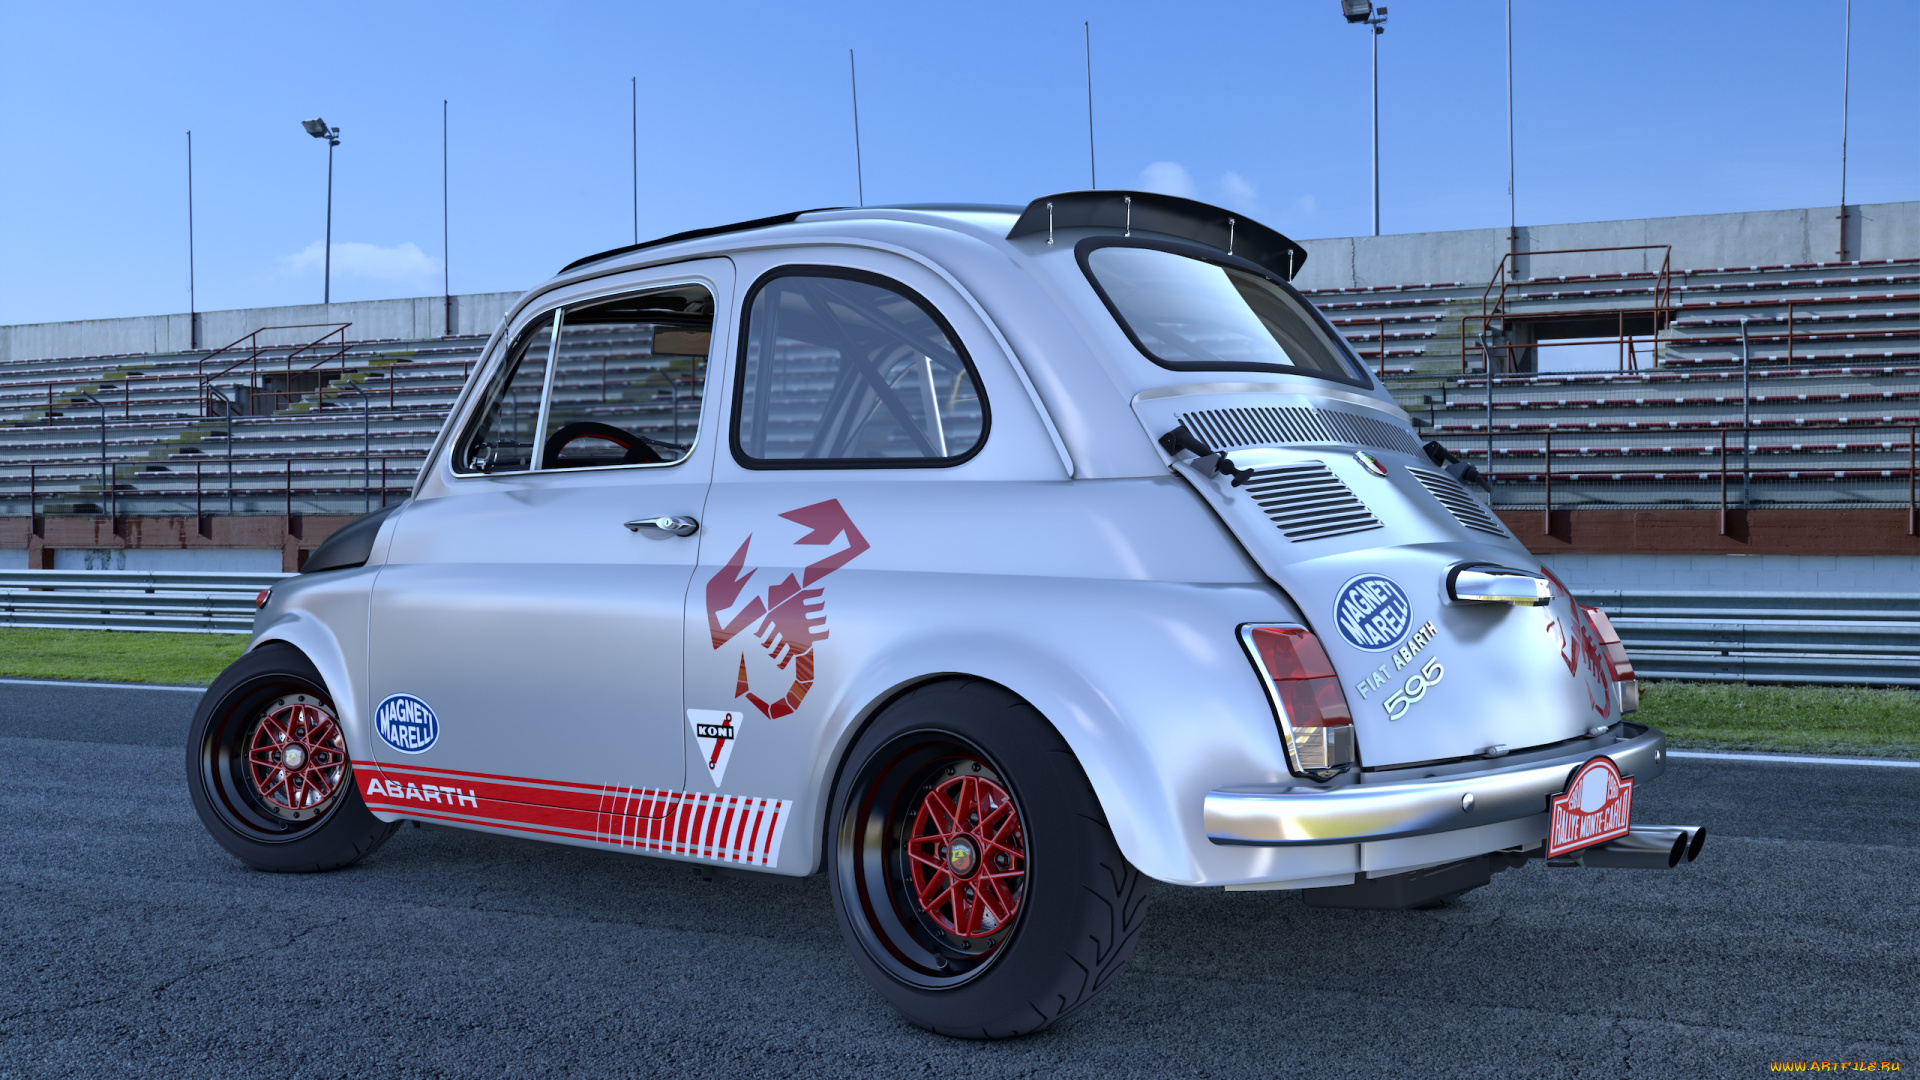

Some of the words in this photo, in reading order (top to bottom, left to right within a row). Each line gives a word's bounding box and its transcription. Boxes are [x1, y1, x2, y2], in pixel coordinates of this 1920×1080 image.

[1340, 580, 1406, 632] MAGNETI
[1342, 594, 1408, 645] MARELLI
[1355, 663, 1391, 700] FIAT
[1392, 620, 1438, 671] ABARTH
[1382, 655, 1444, 721] 595
[380, 699, 433, 730] MAGNETI
[380, 719, 433, 748] MARELLI
[698, 726, 733, 738] KONI
[366, 778, 478, 808] ABARTH
[1554, 805, 1580, 846] RALLYE
[1580, 789, 1629, 839] MONTE-CARLO
